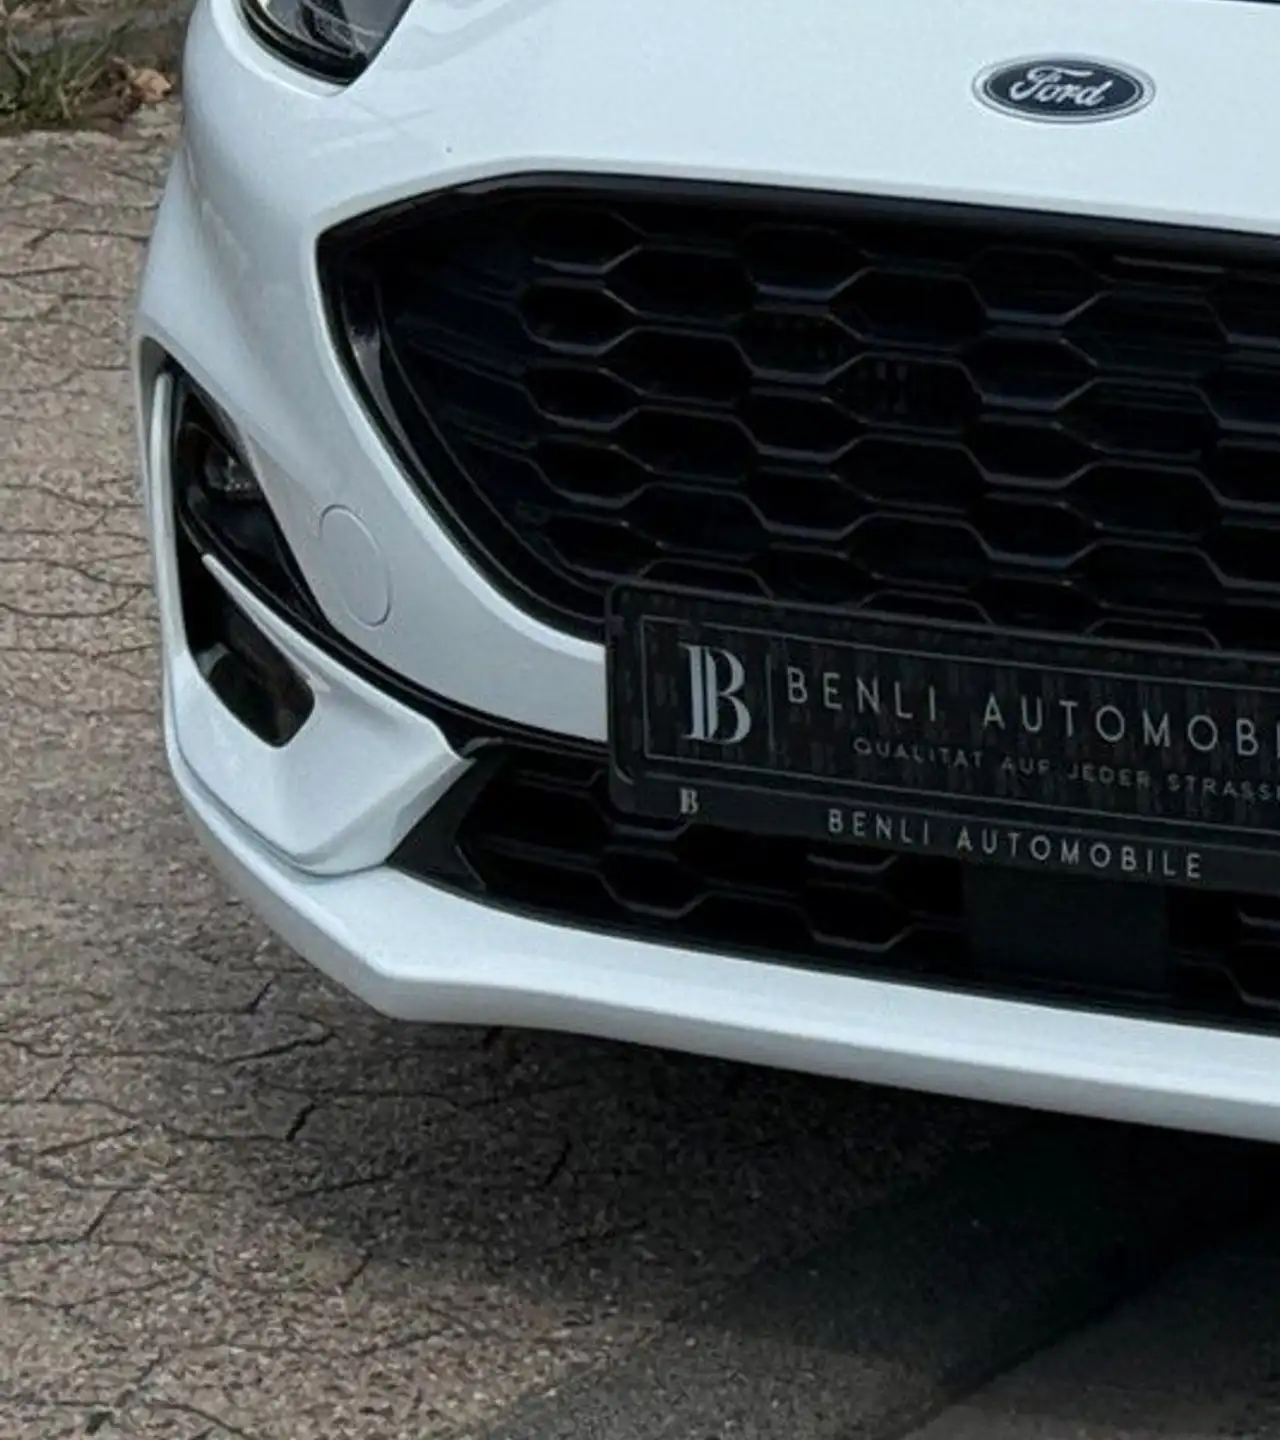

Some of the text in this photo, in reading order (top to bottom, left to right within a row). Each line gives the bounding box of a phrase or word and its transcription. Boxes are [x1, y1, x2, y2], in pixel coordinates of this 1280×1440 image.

[1009, 65, 1113, 107] Ford
[786, 667, 937, 722] BENLI
[1068, 762, 1150, 788] JEDER
[827, 808, 1201, 879] BENLI AUTOMOBILE
